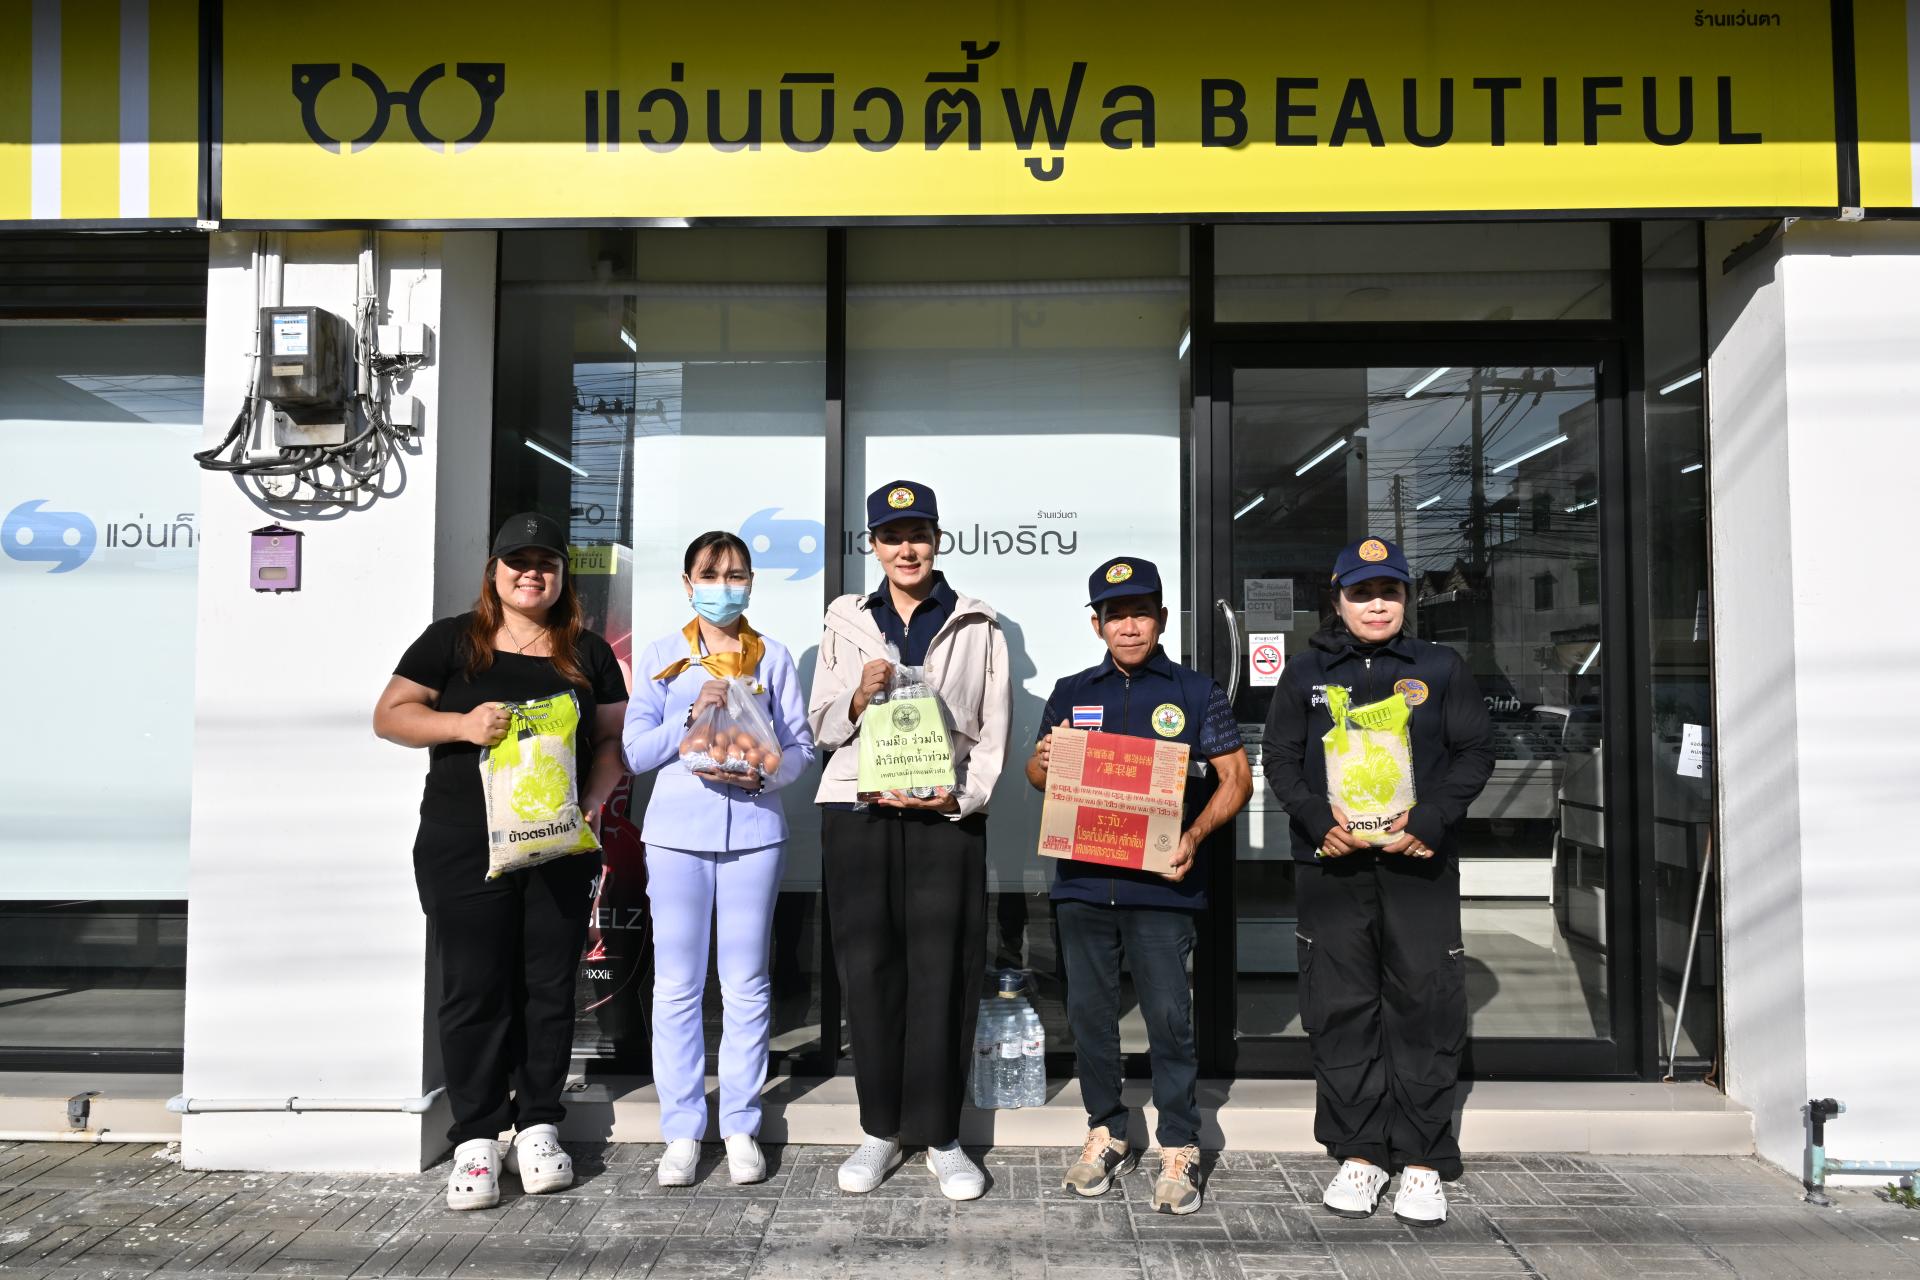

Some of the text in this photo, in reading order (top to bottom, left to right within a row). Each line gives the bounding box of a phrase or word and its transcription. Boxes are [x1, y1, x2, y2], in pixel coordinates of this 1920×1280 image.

[1694, 8, 1781, 29] ร้านแว่นตา
[585, 41, 1763, 182] แว่นบิวตี้ฟูล BEAUTIFUL
[1037, 510, 1077, 520] ร้านแว่นตา
[106, 513, 200, 548] แว่นท็
[912, 731, 943, 745] ร่วมใจ
[509, 820, 577, 843] ข้าวตราไก่แจ้
